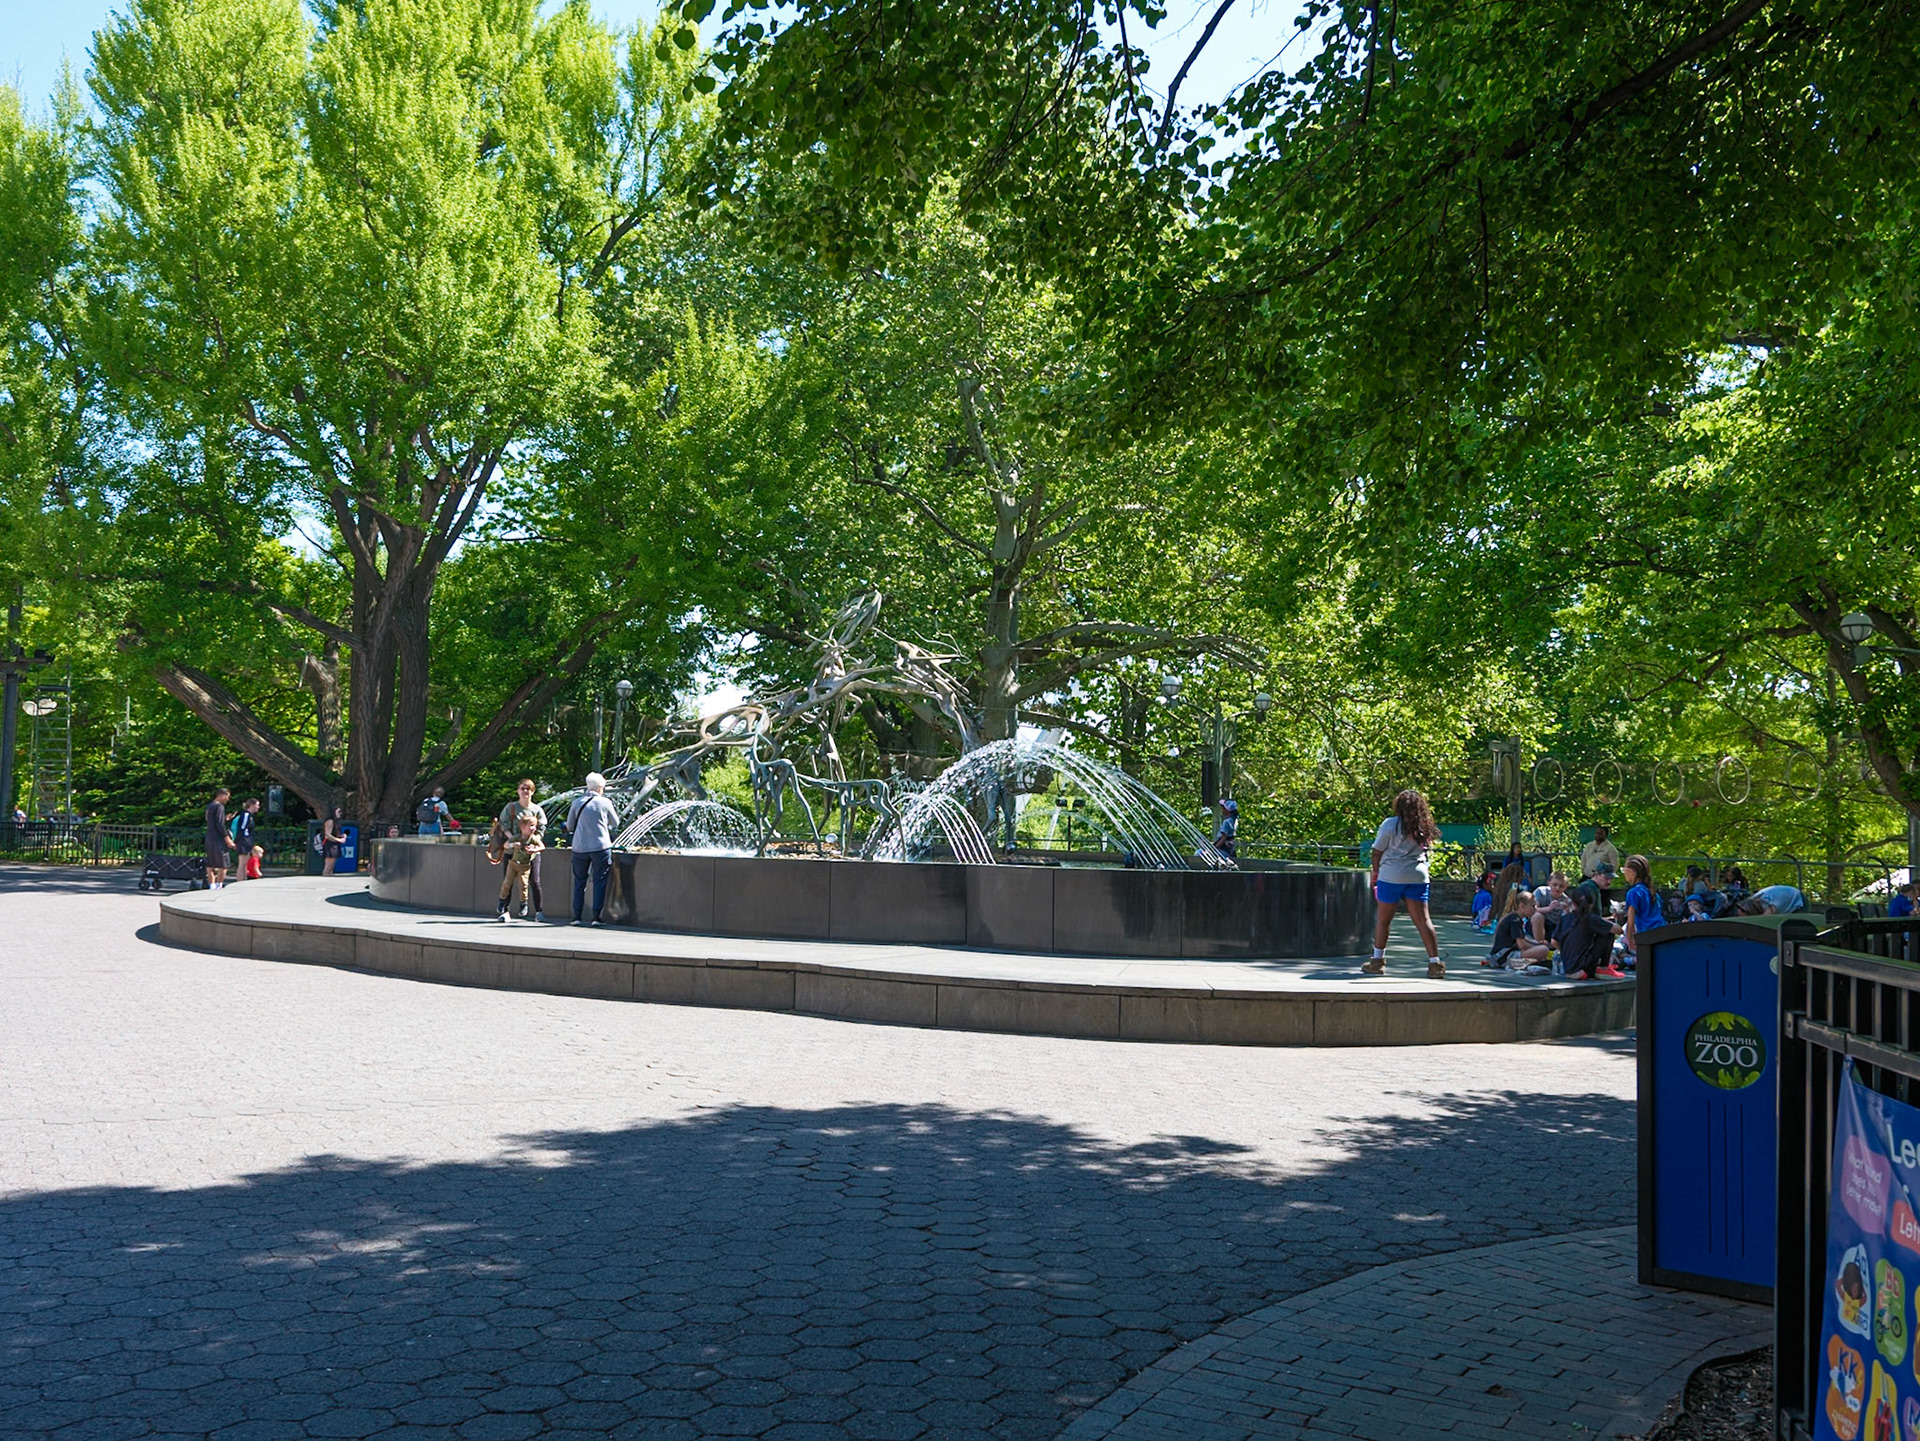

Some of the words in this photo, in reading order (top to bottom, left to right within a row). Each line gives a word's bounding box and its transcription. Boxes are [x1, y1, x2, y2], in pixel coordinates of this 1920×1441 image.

[1695, 1034, 1757, 1046] PHILADELPHIA
[1695, 1042, 1758, 1067] ZOO
[1886, 1123, 1920, 1168] Le
